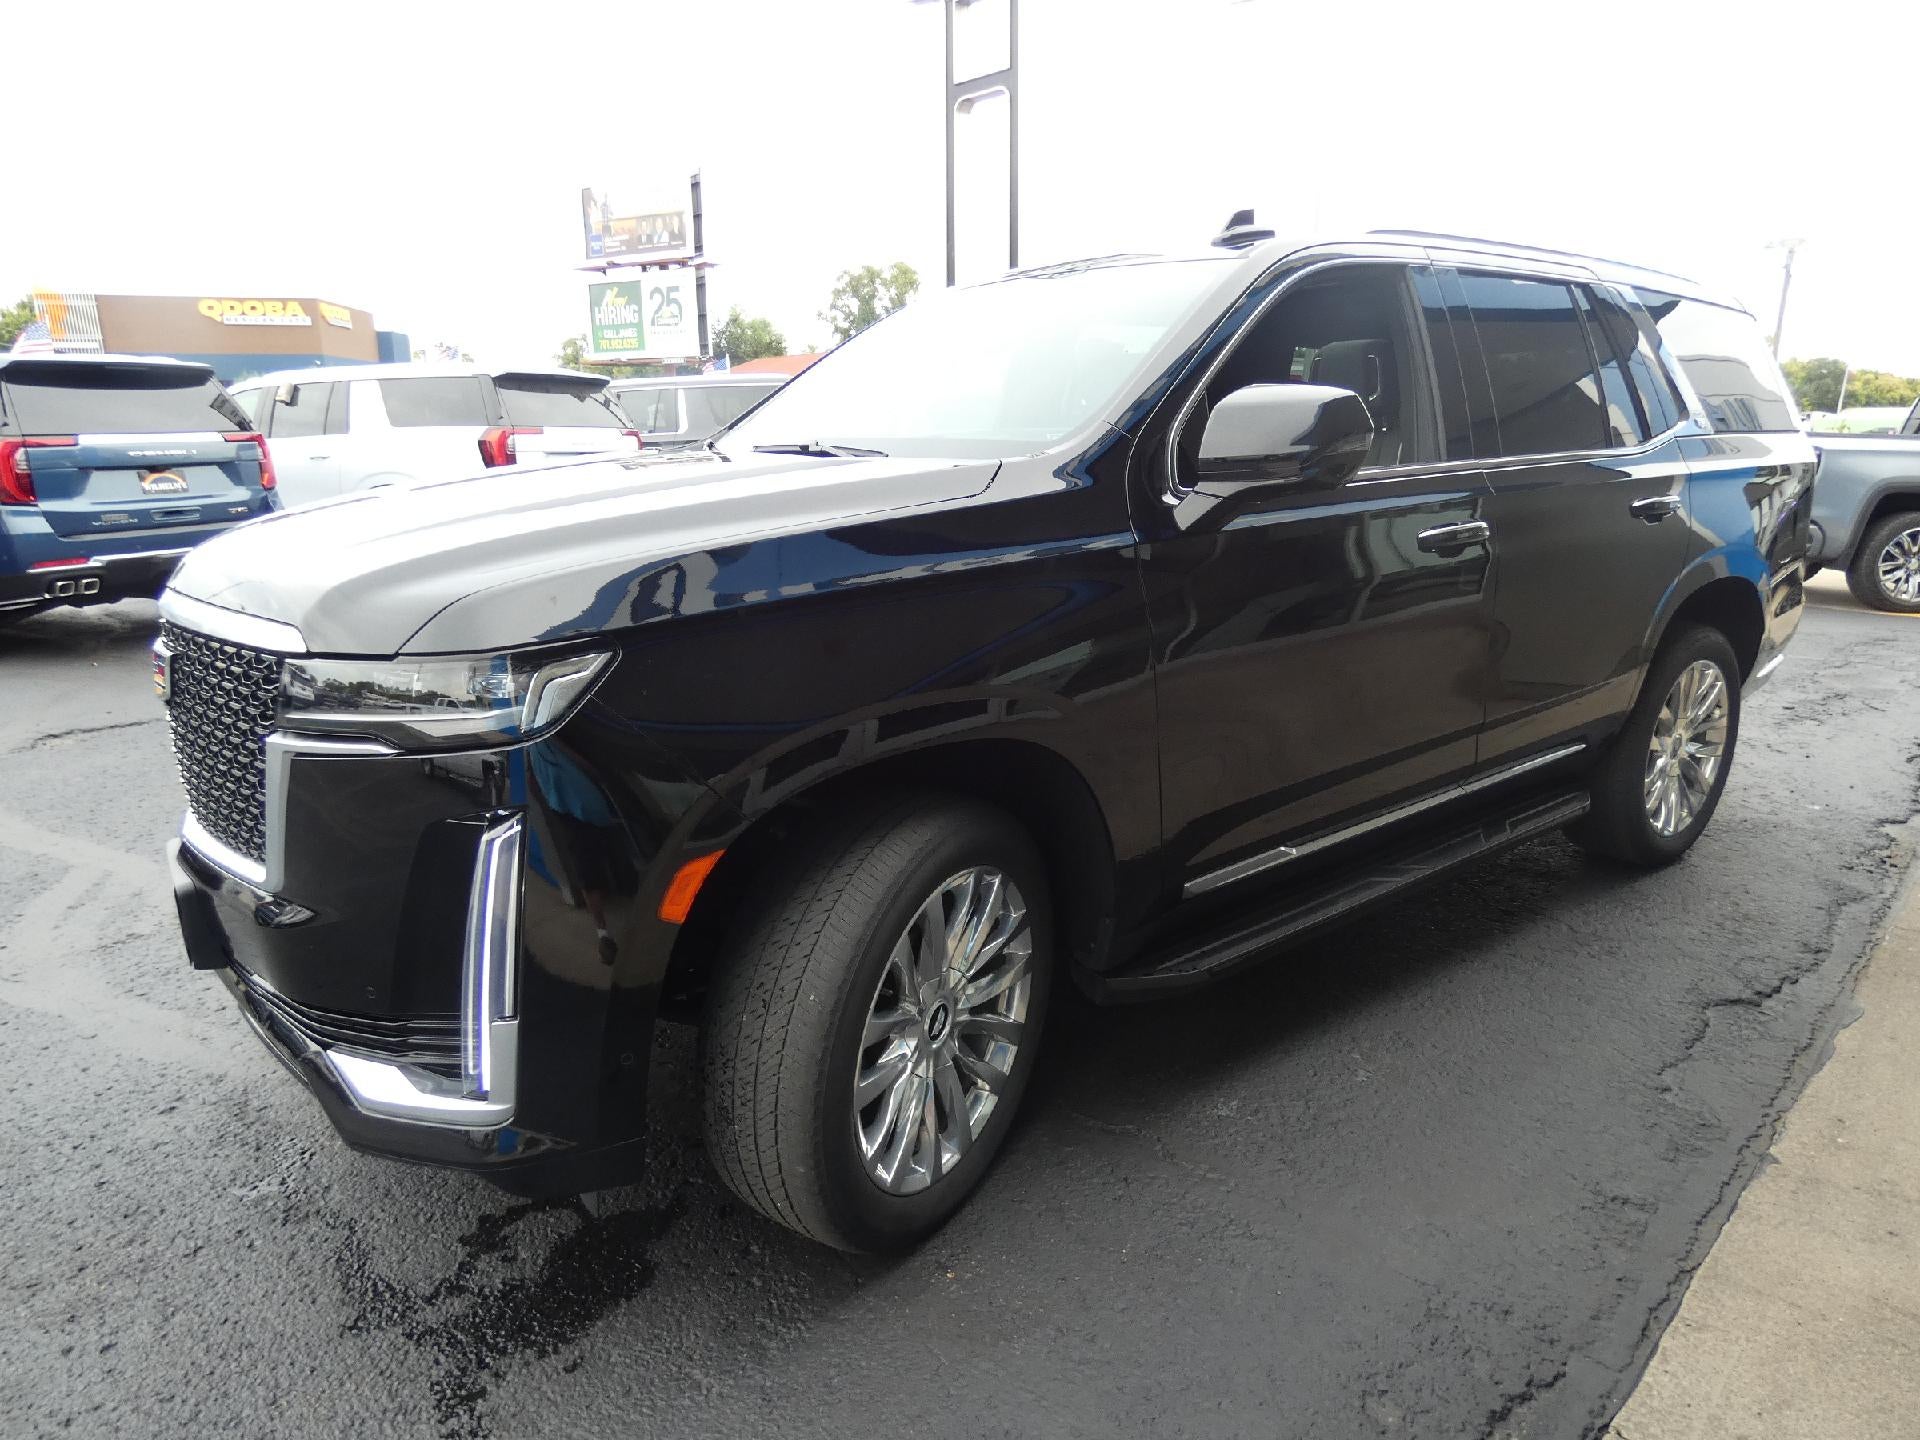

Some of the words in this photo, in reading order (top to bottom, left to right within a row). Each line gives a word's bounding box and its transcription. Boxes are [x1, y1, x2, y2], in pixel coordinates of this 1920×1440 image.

[198, 299, 306, 323] QDOBA
[594, 304, 639, 325] HIRING
[650, 286, 682, 326] 25
